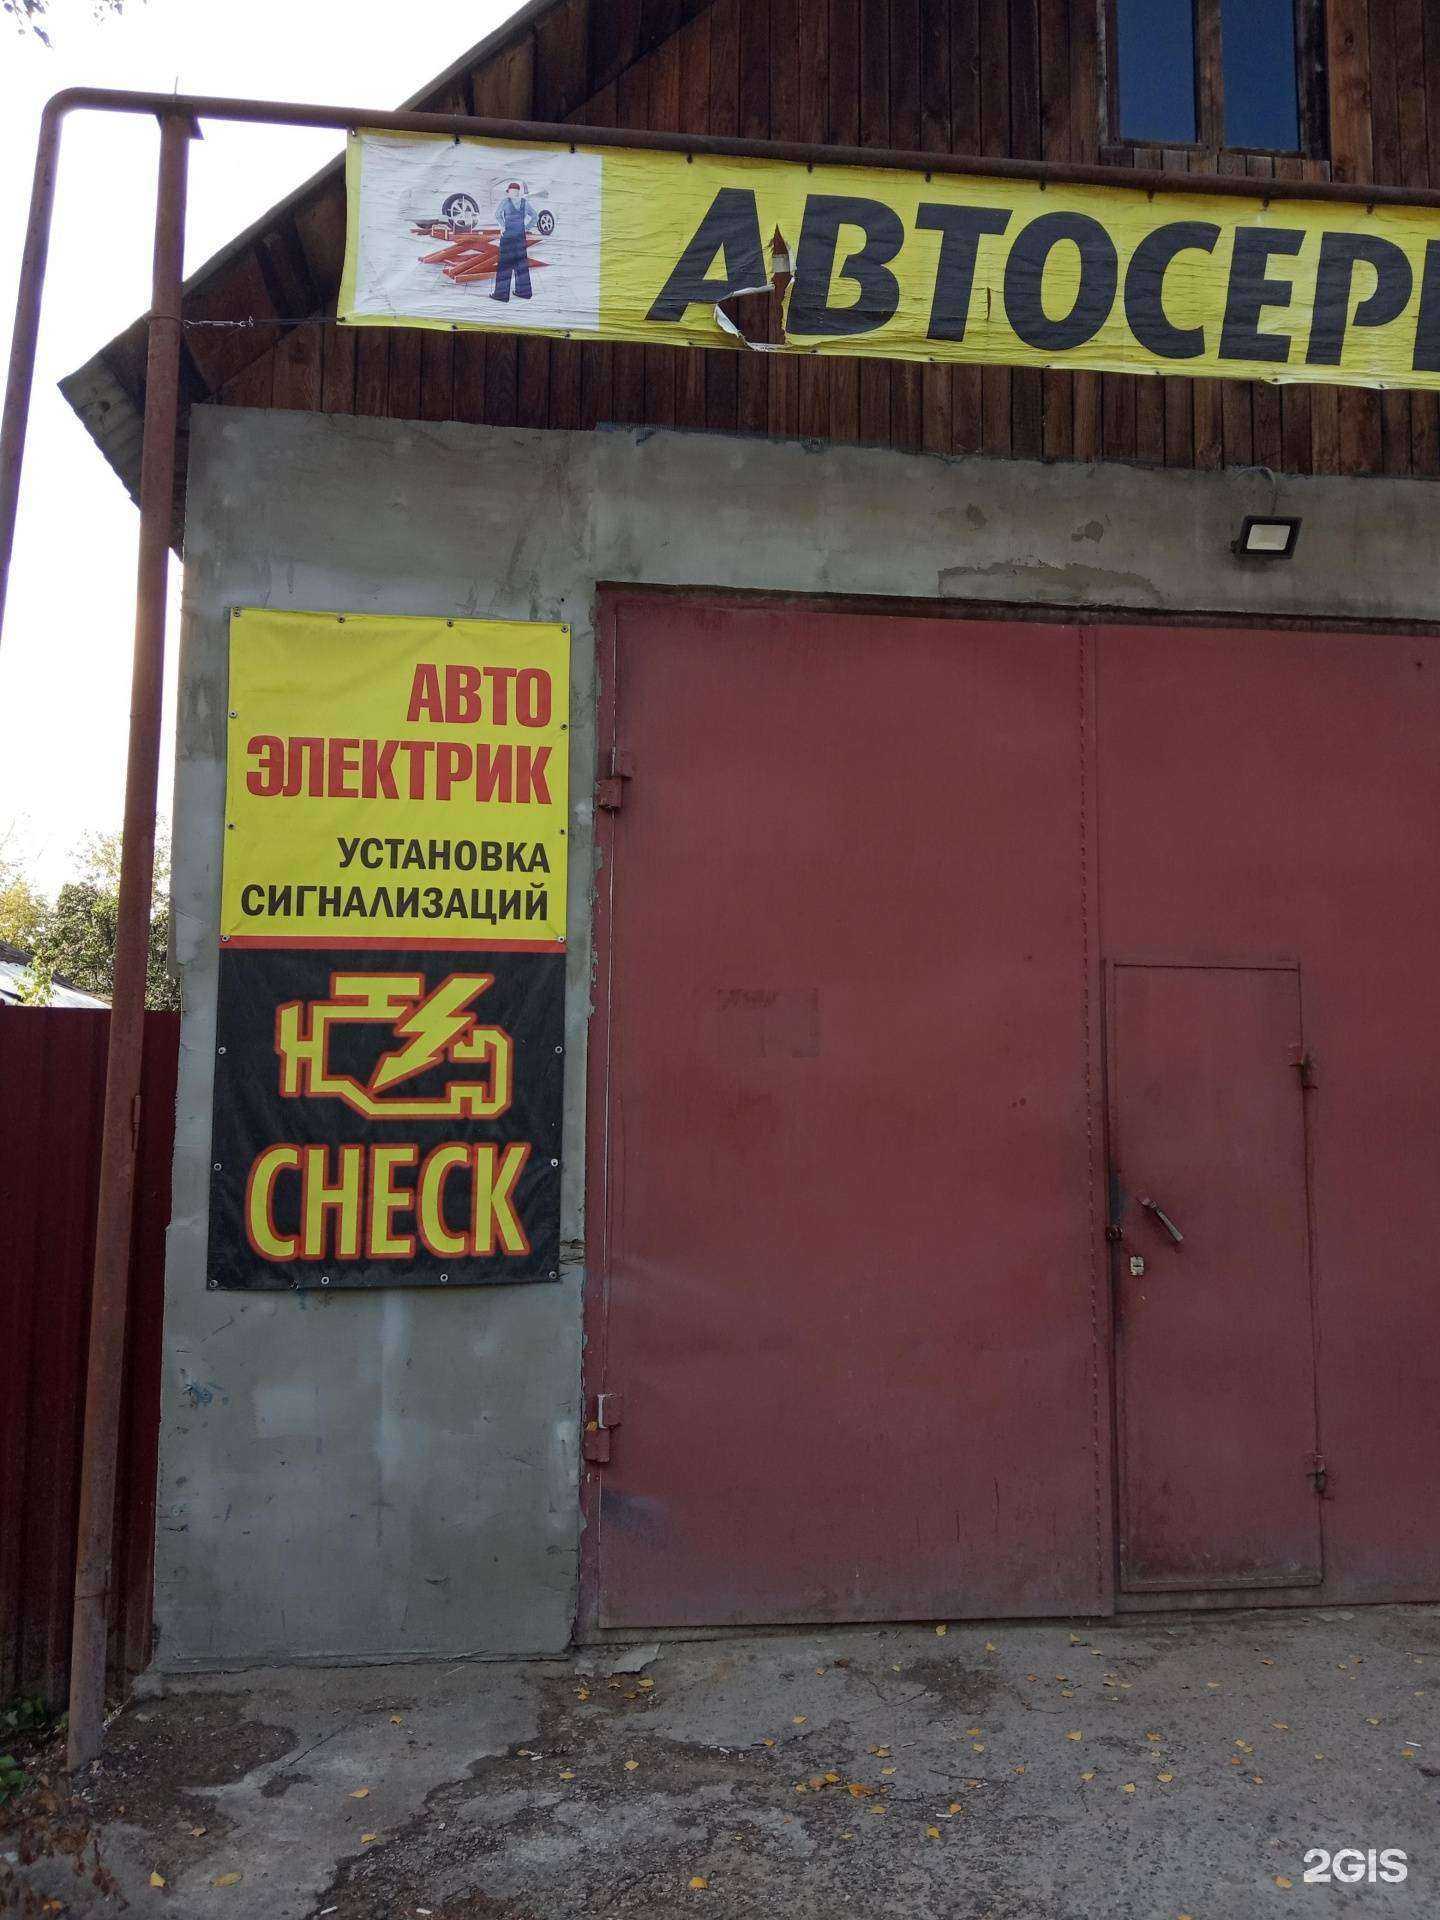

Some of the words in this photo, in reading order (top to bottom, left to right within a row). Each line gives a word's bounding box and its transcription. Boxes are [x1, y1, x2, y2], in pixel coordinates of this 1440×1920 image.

[644, 187, 1440, 371] АВТОСЕР
[406, 663, 552, 728] АВТО
[246, 735, 553, 805] ЭЛЕКТРИК
[337, 837, 551, 873] УСТАНОВКА
[241, 882, 548, 925] СИГНАЛИЗАЦИЙ
[245, 1142, 531, 1262] CHECK
